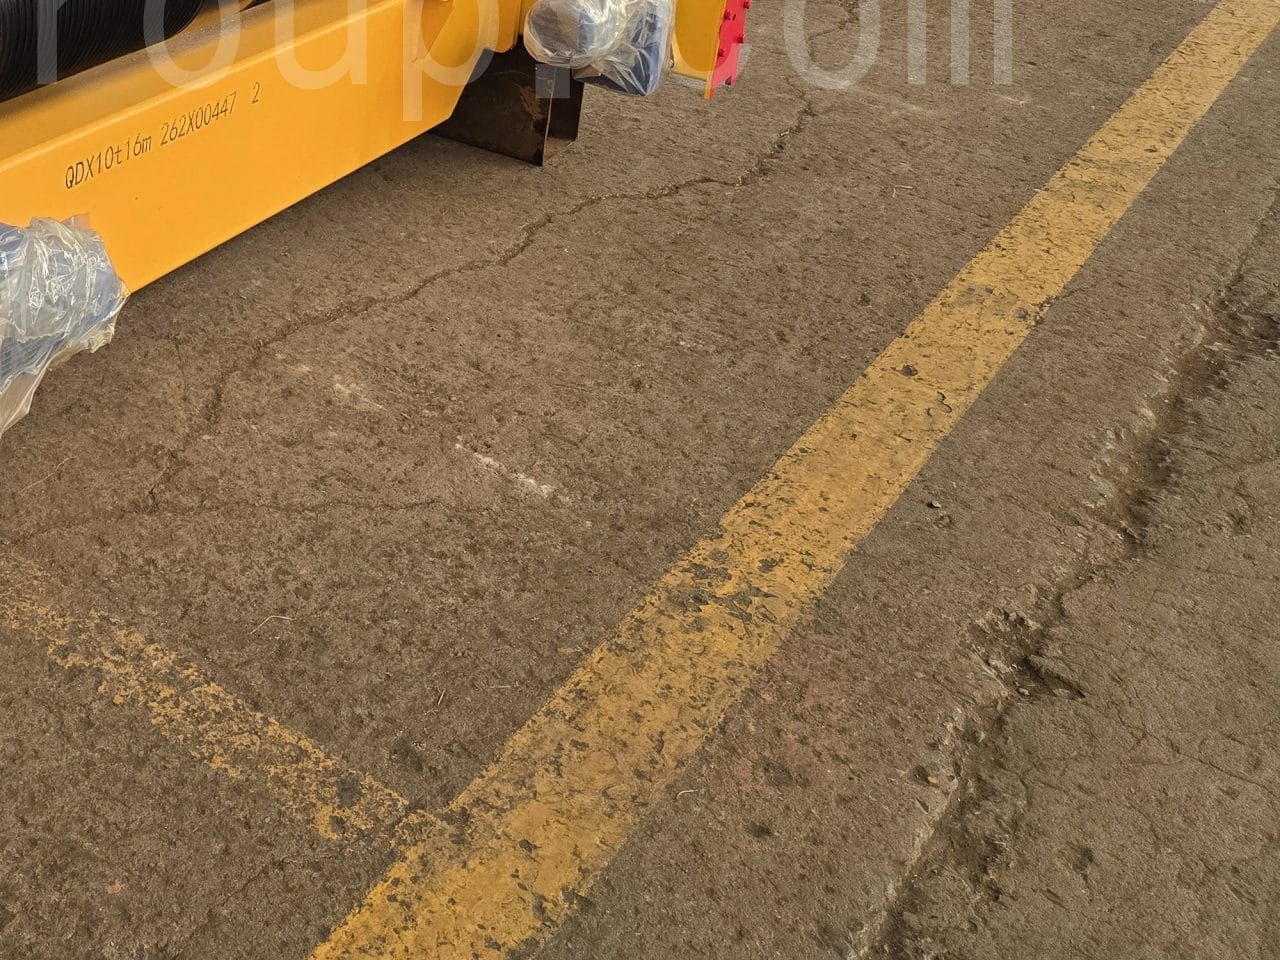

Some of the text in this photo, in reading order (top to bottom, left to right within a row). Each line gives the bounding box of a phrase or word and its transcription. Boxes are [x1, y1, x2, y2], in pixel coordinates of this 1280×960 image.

[65, 81, 261, 189] QDX10t16m 262X00447 2
